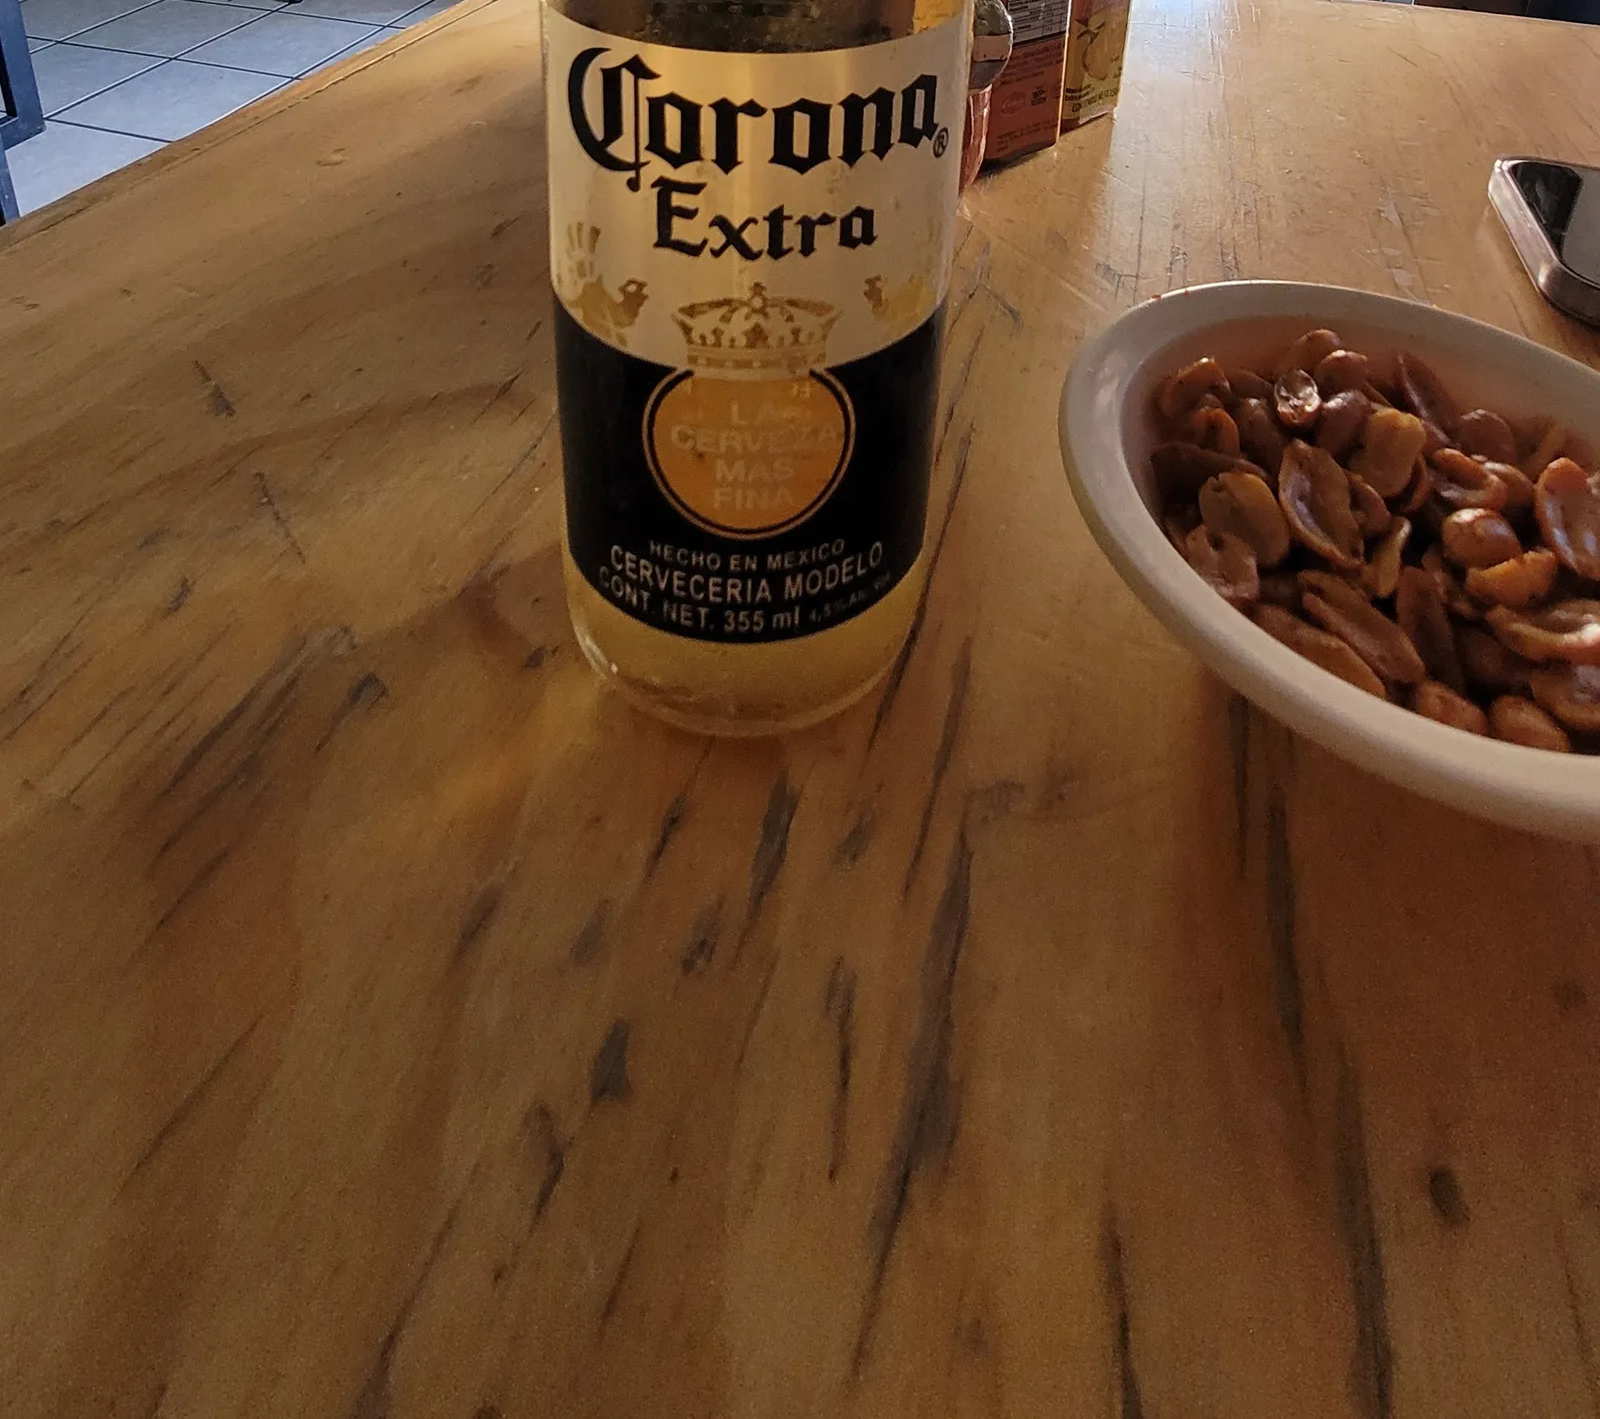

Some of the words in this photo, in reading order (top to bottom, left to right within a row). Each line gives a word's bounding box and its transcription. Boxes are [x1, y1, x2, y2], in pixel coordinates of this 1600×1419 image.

[568, 47, 941, 192] Corona
[651, 175, 878, 261] Extra
[670, 423, 838, 454] CERVEZA
[715, 457, 794, 483] MAS
[713, 485, 795, 511] FINA
[650, 539, 721, 571] HECHO
[730, 554, 758, 572] EN
[767, 538, 845, 571] MEXICO
[610, 544, 772, 604] CERVECERIA
[784, 541, 883, 600] MODELO
[663, 600, 715, 630] NET.
[724, 610, 764, 633] 355
[772, 606, 799, 629] ml
